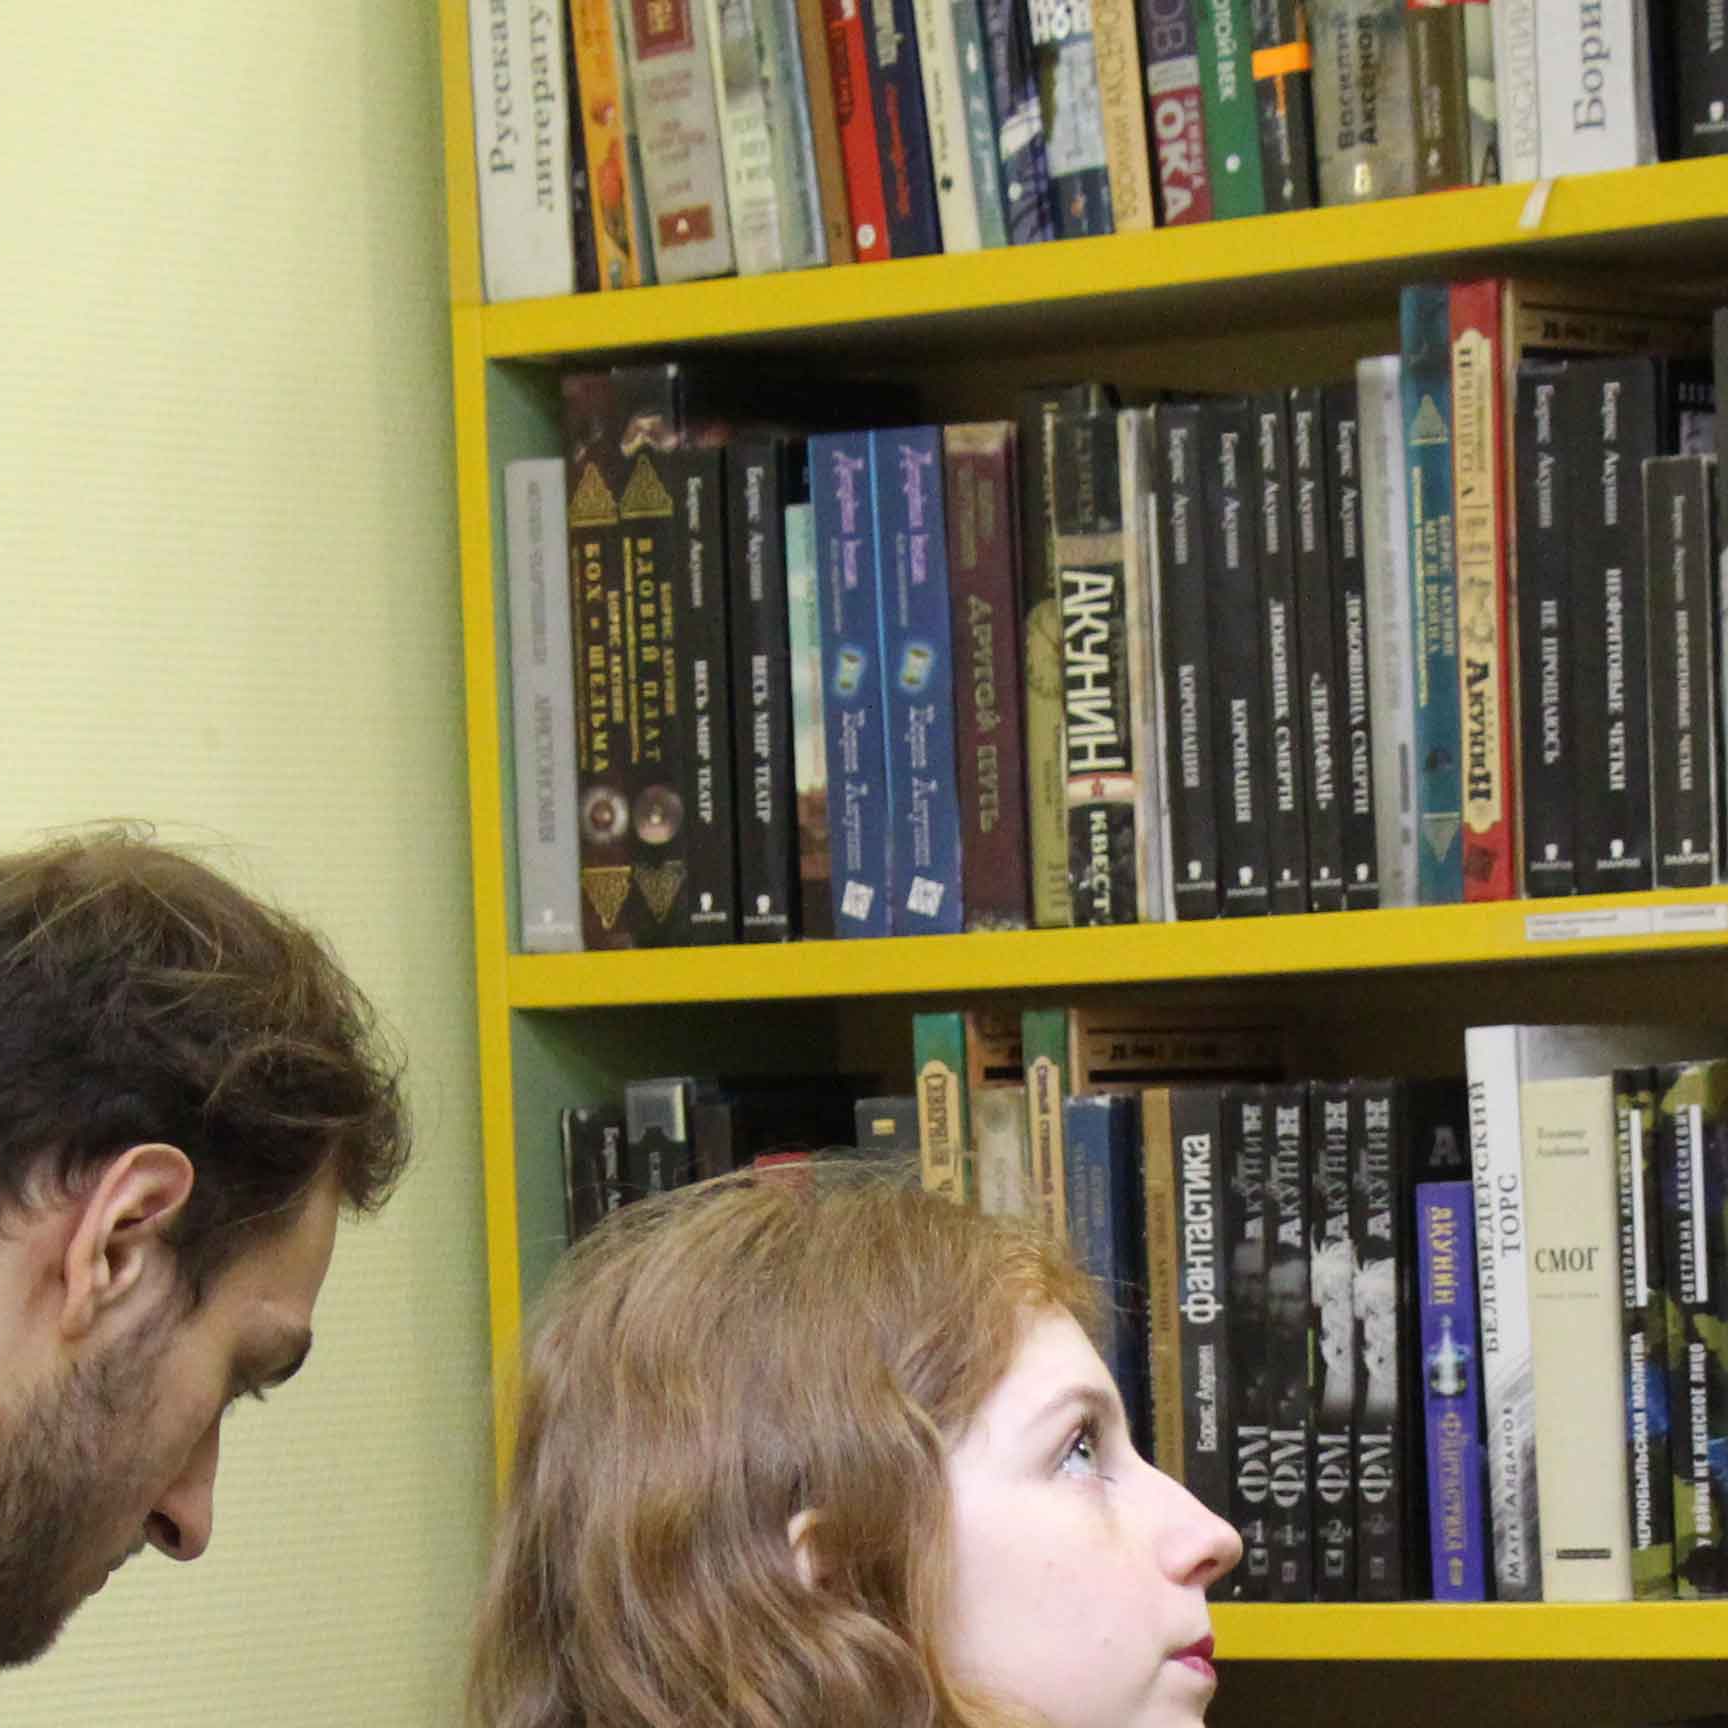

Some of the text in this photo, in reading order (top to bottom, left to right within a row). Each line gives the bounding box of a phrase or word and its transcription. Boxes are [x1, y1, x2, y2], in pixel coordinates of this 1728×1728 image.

[1169, 428, 1192, 565] Борис Акунин
[1219, 432, 1243, 569] Борис Акунин
[1258, 413, 1281, 555] Борис Акунин
[1293, 411, 1318, 553] Борис Акунин
[1337, 420, 1359, 558] Борис Акунин
[1534, 385, 1555, 528] Борис Акунин
[1600, 381, 1621, 525] Борис Акунин
[686, 477, 706, 608] Борис Акунин
[744, 466, 765, 599] Борис Акунин
[584, 544, 608, 772] БОХ ШЕЛЬМА
[643, 681, 660, 761] ПЛАТ
[967, 596, 1000, 832] ДРУГОЙ ПУТЬ
[1061, 570, 1125, 770] АКУНИН
[1177, 664, 1199, 788] КОРОНАЦИЯ
[1540, 600, 1560, 764] НЕ ПРОЩАЮСЬ
[1605, 568, 1625, 790] НЕФРИТОВЫЕ ЧЕТКИ
[694, 659, 713, 825] ВЕСЬ МИР ТЕАТР
[751, 654, 771, 823] ВЕСЬ МИР ТЕАТР
[1229, 699, 1251, 823] КОРОНАЦИЯ
[1274, 725, 1293, 811] СМЕРТИ
[1351, 730, 1370, 815] СМЕРТИ
[1088, 809, 1110, 914] КВЕСТ
[1181, 1133, 1222, 1323] фантастика
[1241, 1102, 1265, 1240] АКУНИН
[1277, 1105, 1301, 1247] АКУНИН
[1325, 1100, 1349, 1239] АКУНИН
[1366, 1099, 1391, 1240] АКУНИН
[1469, 1080, 1500, 1354] БЕЛЬВЕДЕРСКИЙ
[1498, 1173, 1521, 1258] ТОРС
[1674, 1103, 1695, 1303] СВЕТЛАНА АЛЕКСИЕВИЧ
[1430, 1206, 1454, 1305] АКУНИН
[1534, 1247, 1599, 1272] СМОГ
[1620, 1223, 1636, 1308] СВЕТЛАНА
[1195, 1345, 1217, 1451] Борис Акунин
[1630, 1333, 1653, 1550] ЧЕРНОБЫЛЬСКАЯ МОЛИТВА
[1687, 1342, 1710, 1477] НЕ ЖЕНСКОЕ ЛИЦО
